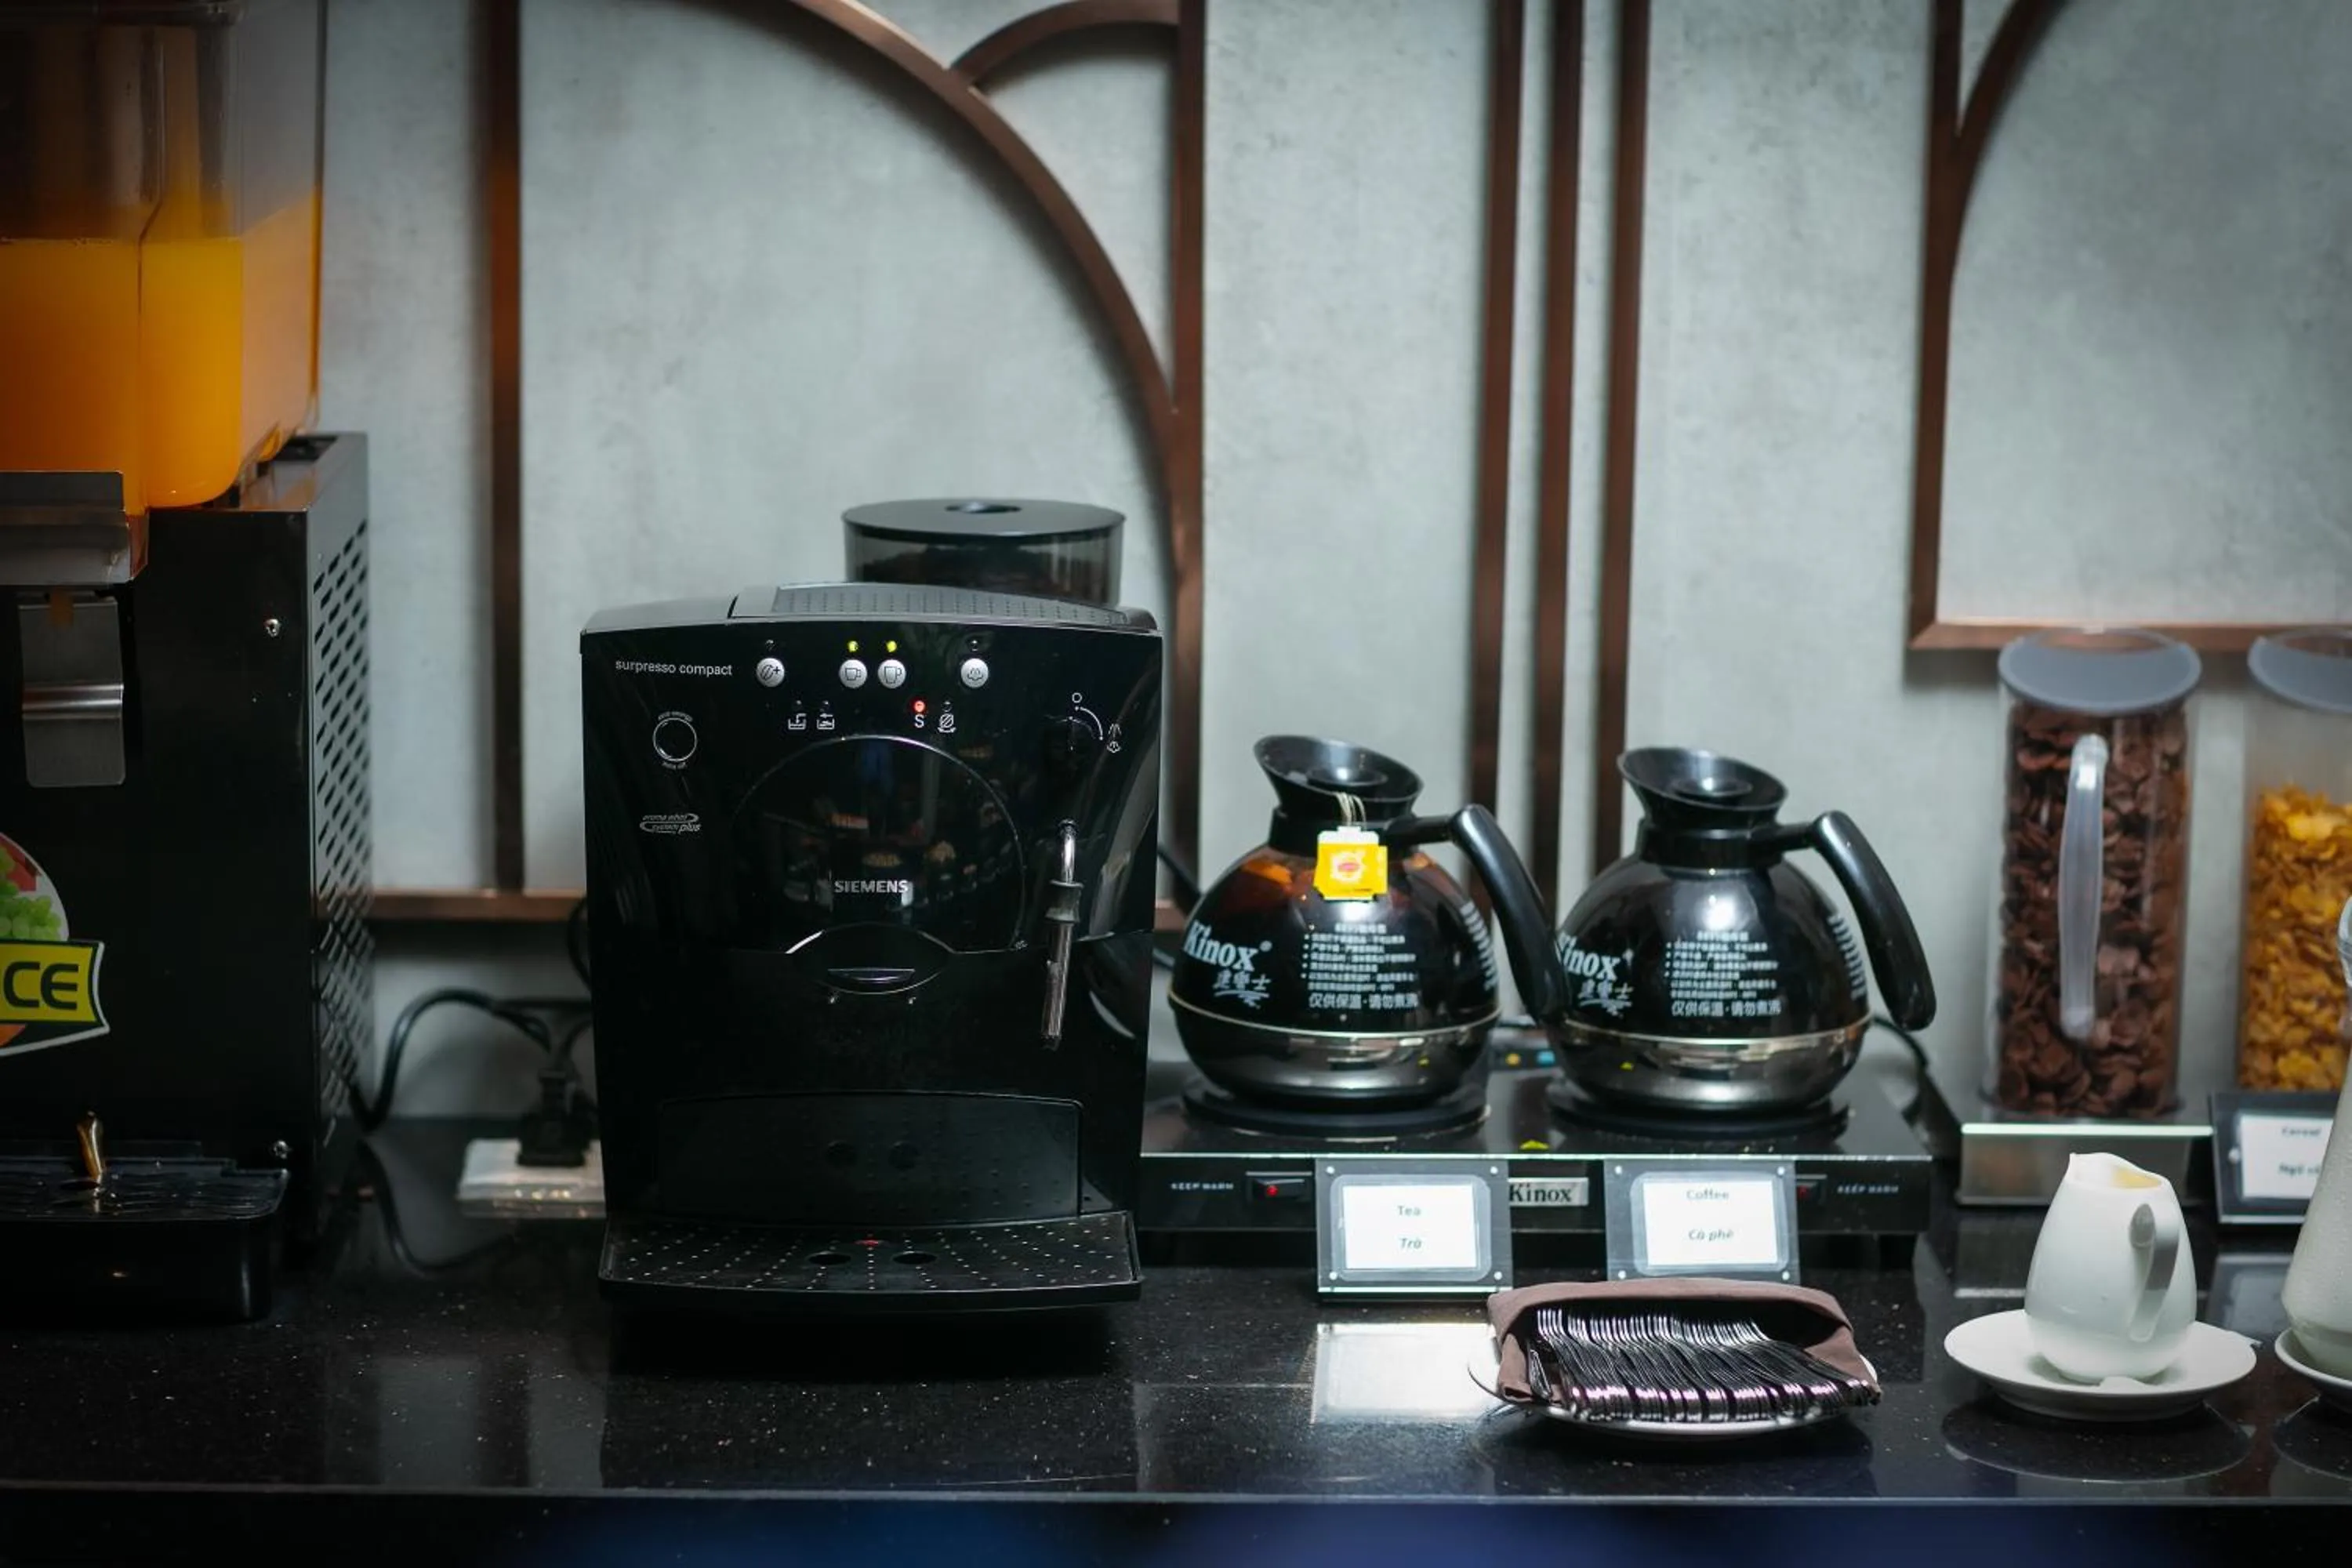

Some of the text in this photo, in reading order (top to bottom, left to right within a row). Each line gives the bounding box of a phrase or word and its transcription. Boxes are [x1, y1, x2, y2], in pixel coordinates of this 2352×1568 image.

[615, 659, 733, 677] surpresso compact
[914, 713, 925, 728] S
[833, 879, 909, 894] SIEMENS
[1182, 919, 1259, 972] Kinox
[1508, 1183, 1572, 1203] Kinox
[1686, 1188, 1730, 1200] Coffee
[1397, 1205, 1422, 1216] Tea
